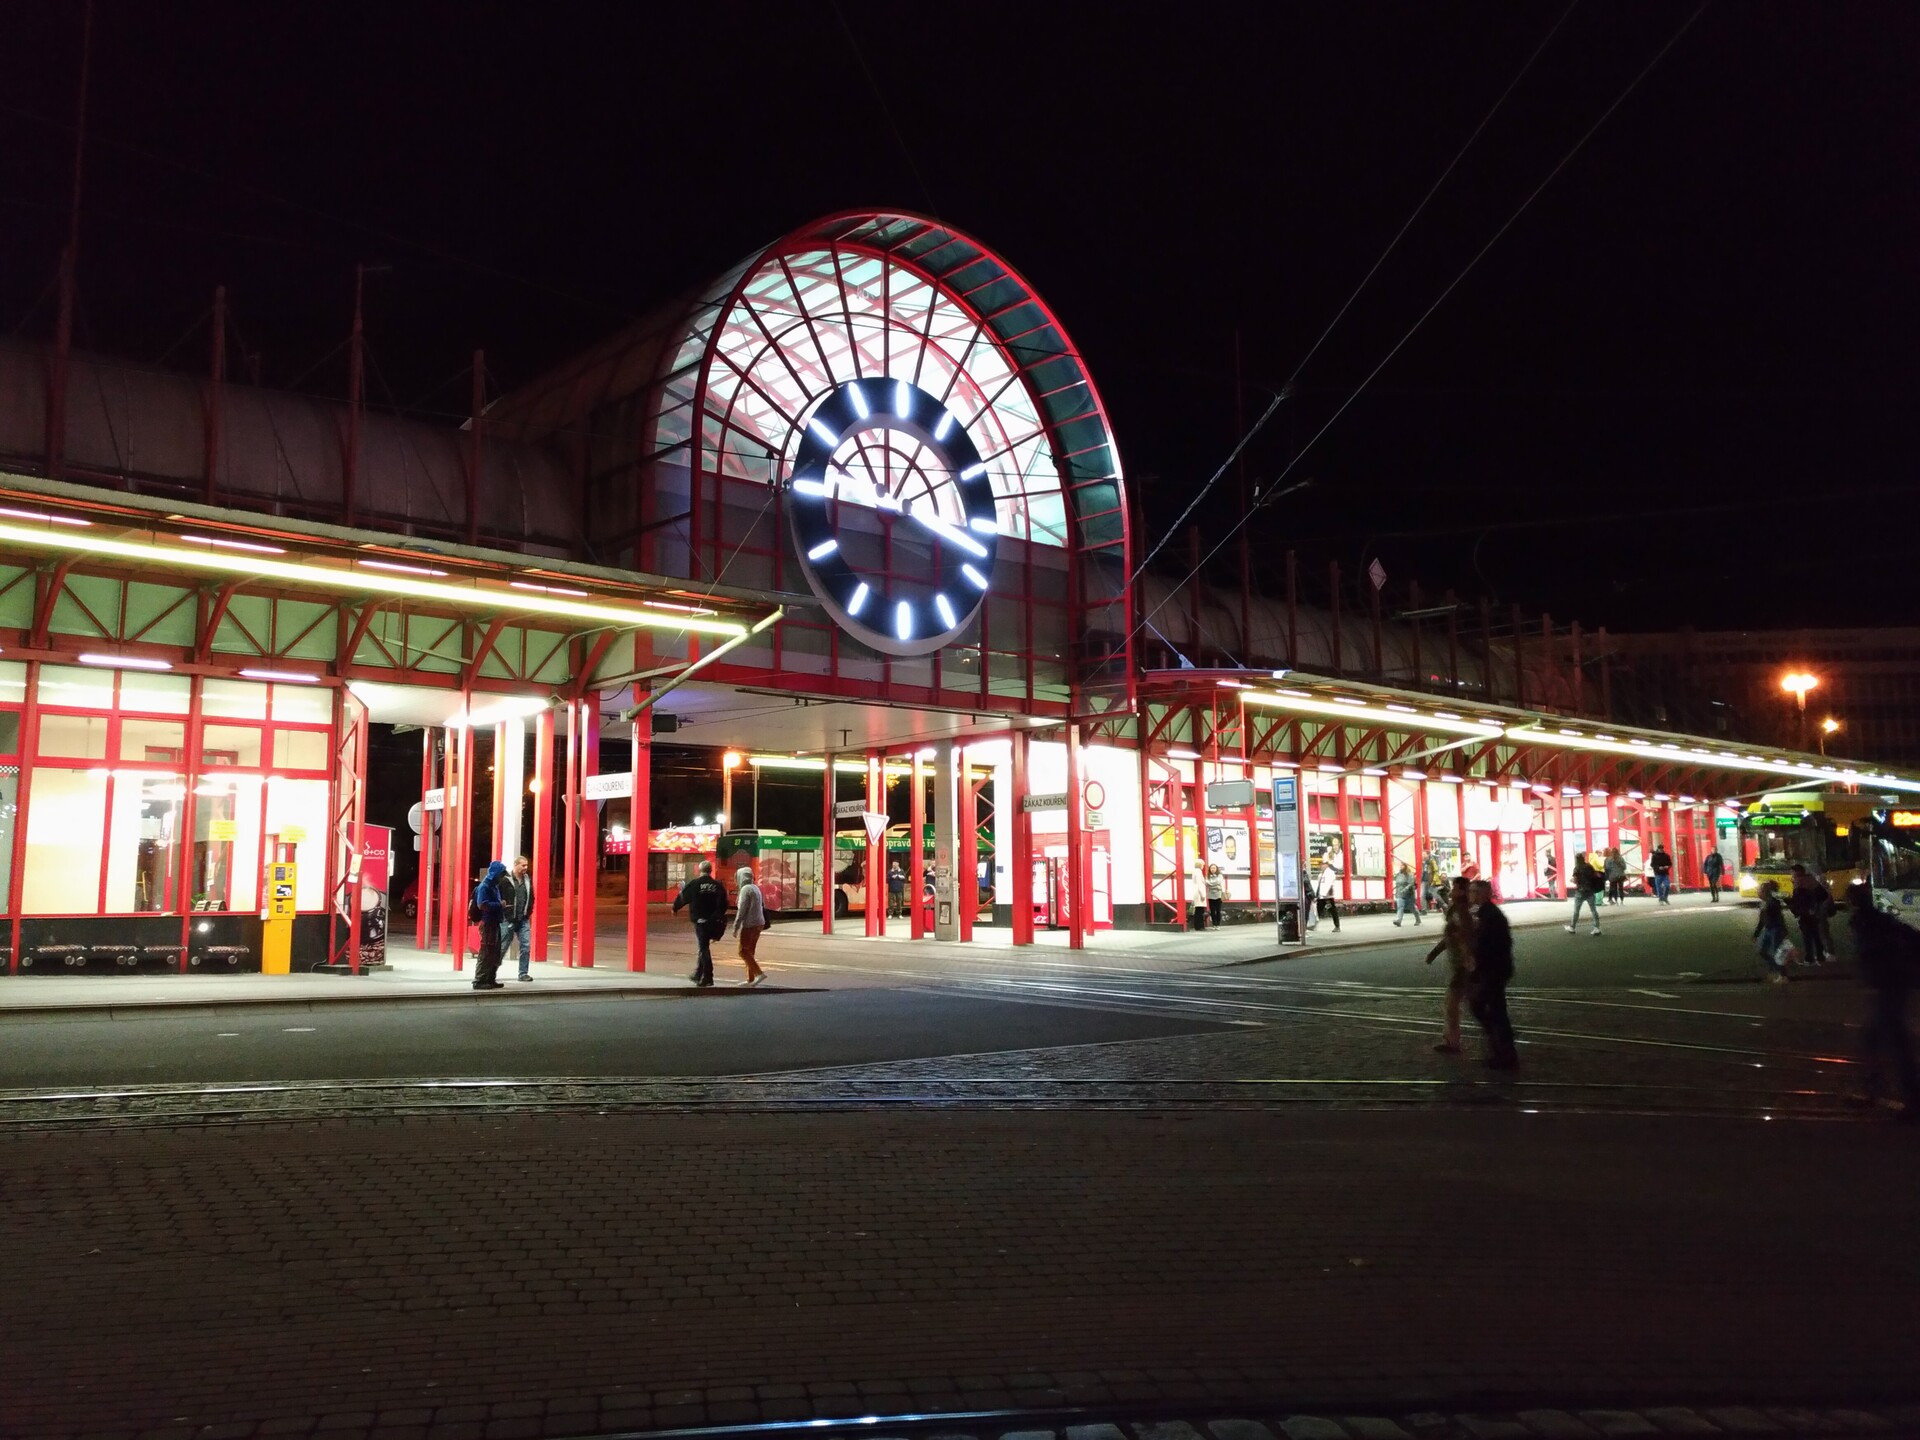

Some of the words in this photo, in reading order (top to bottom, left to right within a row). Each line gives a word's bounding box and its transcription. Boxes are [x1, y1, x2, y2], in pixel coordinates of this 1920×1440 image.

[848, 803, 866, 813] KOUŘEN
[1024, 798, 1042, 808] ZÁKAZ
[1894, 811, 1913, 827] 22
